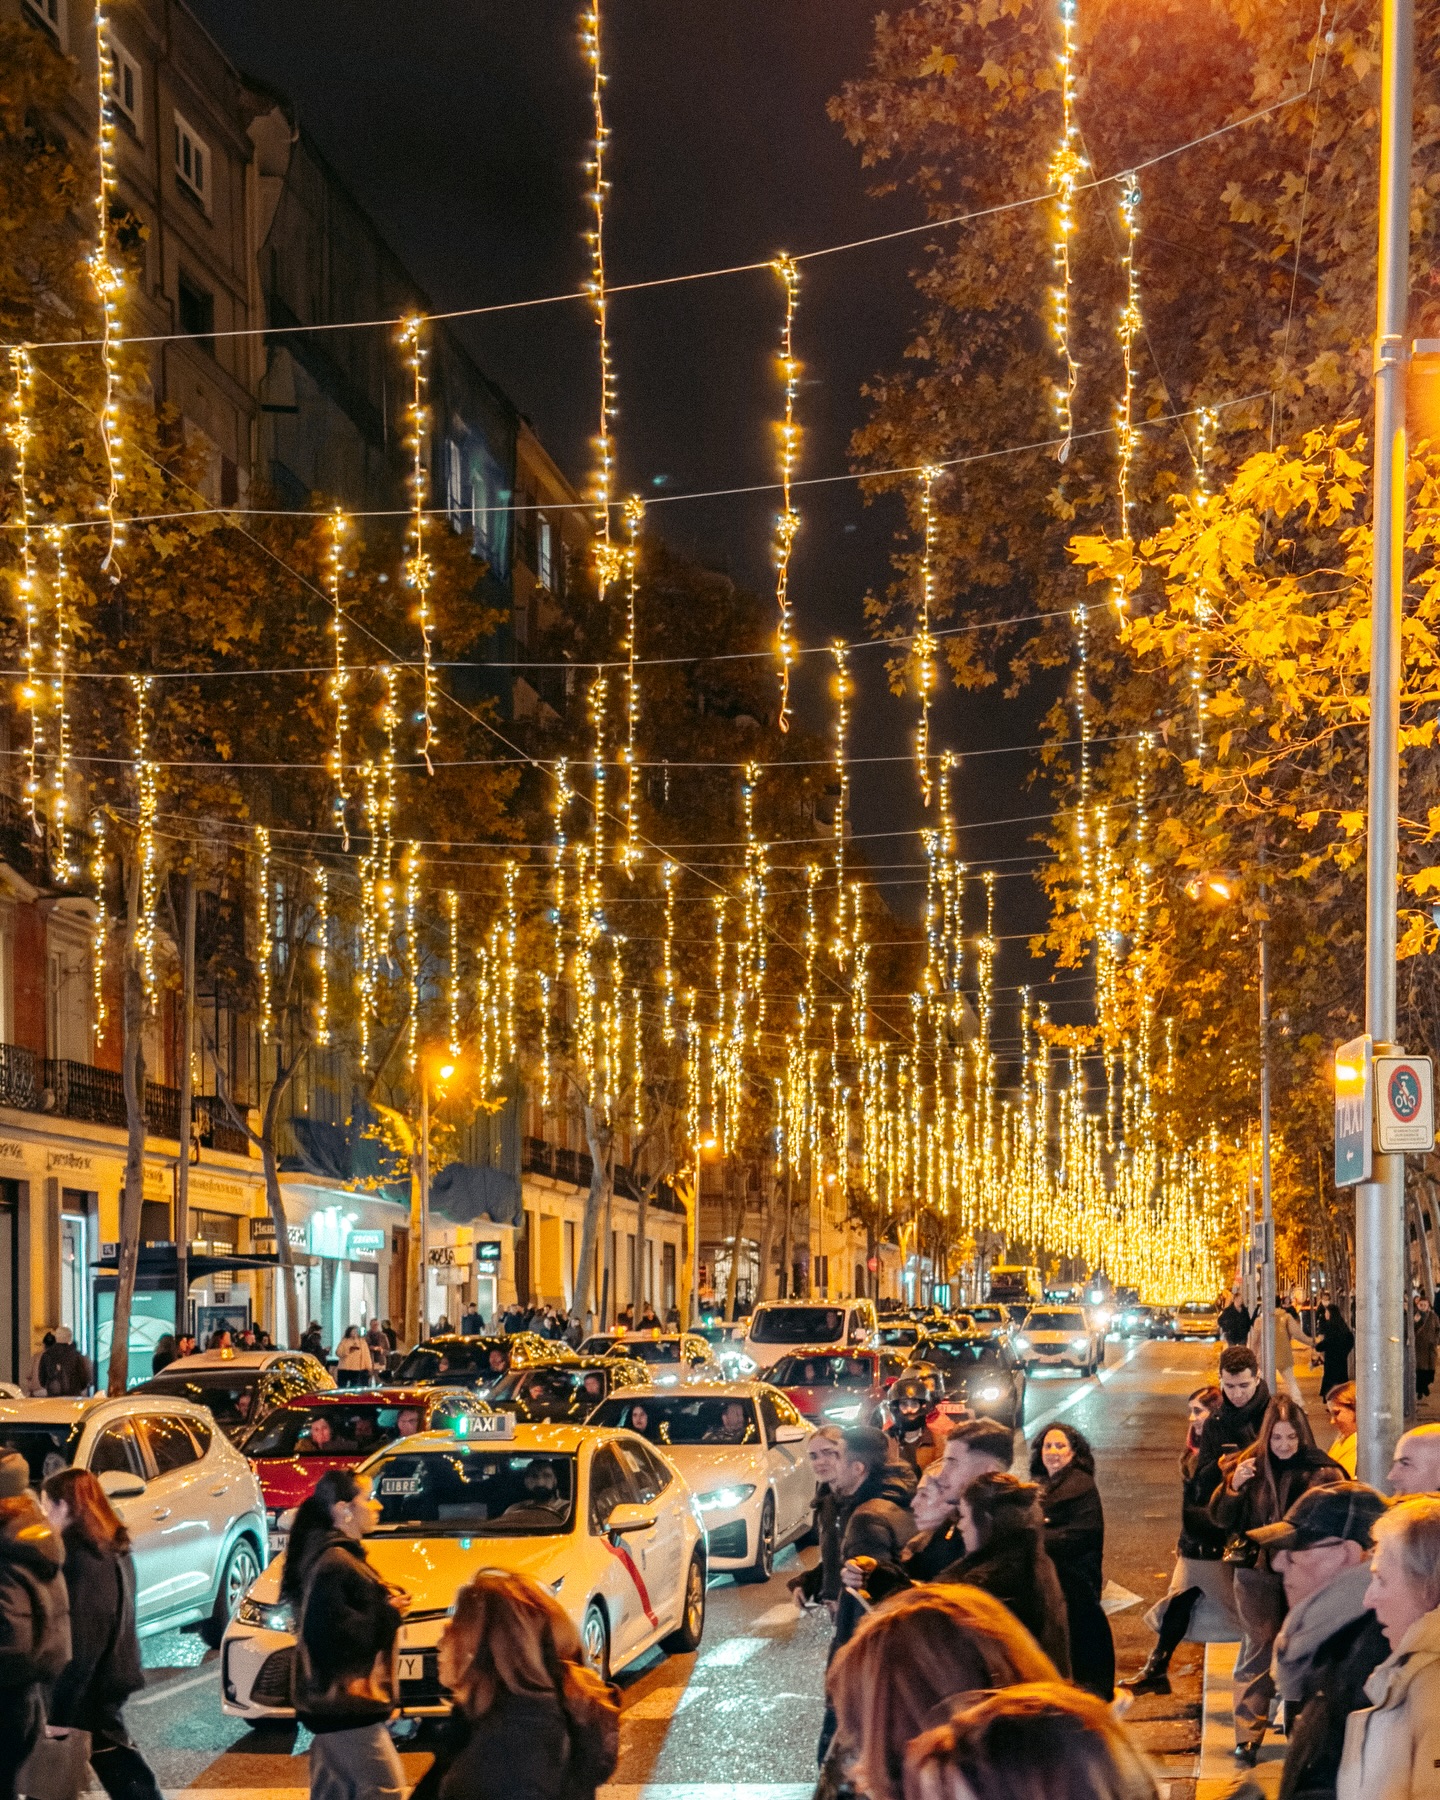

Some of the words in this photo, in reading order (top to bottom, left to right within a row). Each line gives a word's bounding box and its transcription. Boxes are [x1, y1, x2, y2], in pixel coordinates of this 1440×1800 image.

[1337, 1101, 1363, 1138] TAXI
[469, 1416, 495, 1431] TAXI
[386, 1481, 416, 1491] LIBRE
